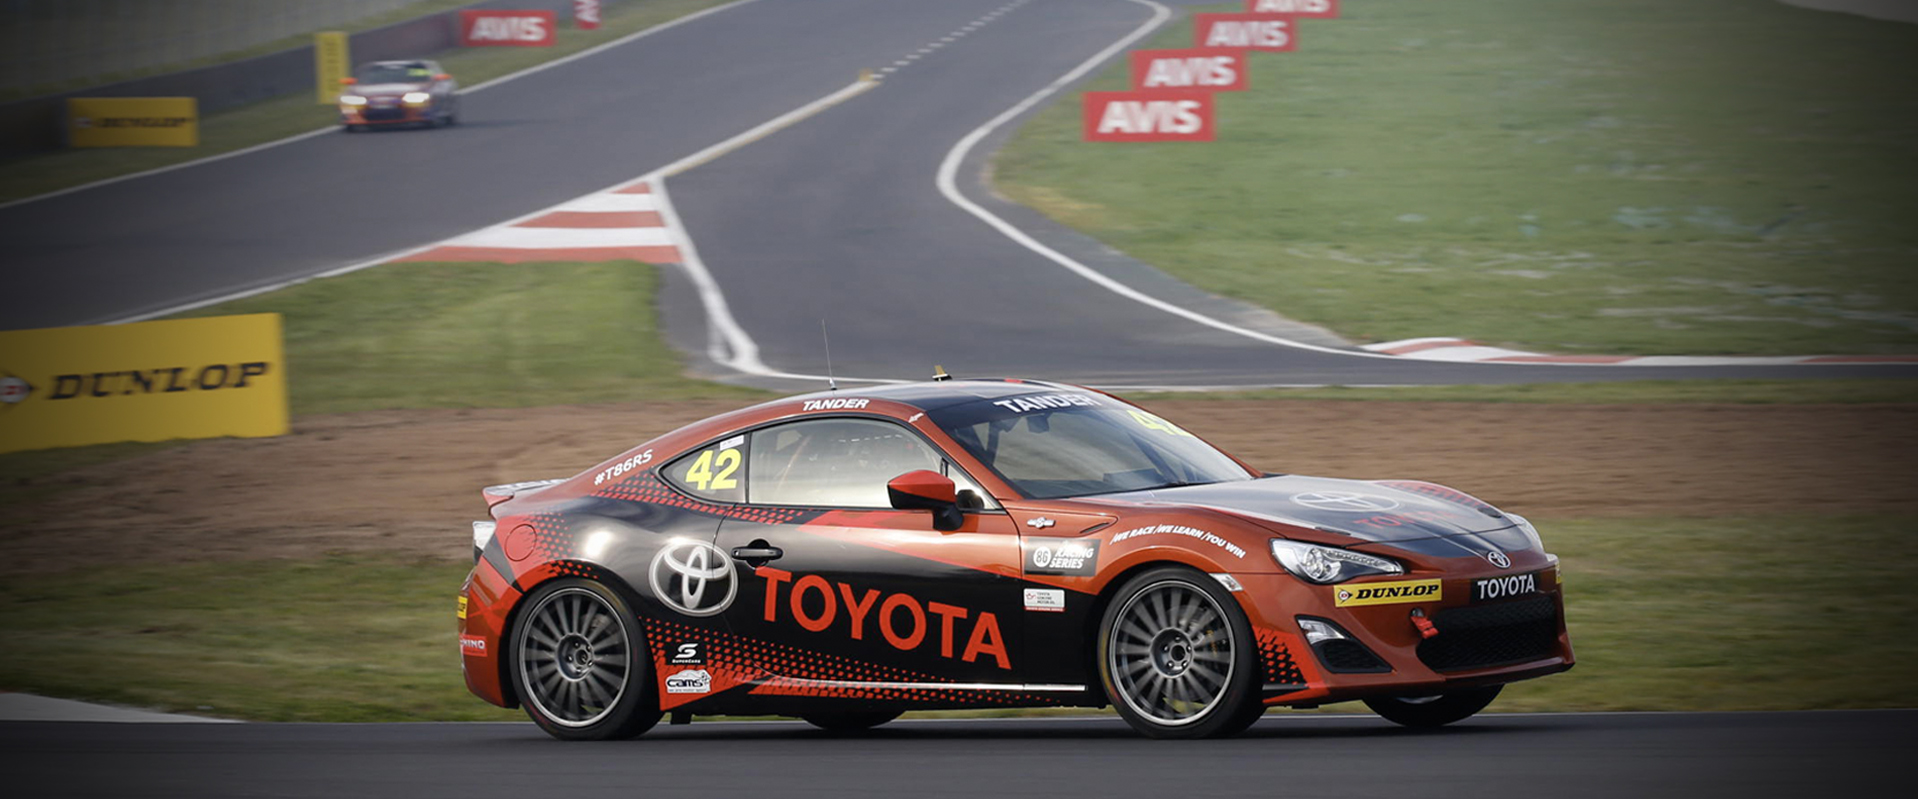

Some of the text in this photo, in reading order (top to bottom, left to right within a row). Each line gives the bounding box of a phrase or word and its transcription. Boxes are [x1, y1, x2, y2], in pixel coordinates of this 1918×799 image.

[1205, 21, 1288, 47] AVIS
[1143, 56, 1236, 87] AVIS
[1097, 100, 1202, 133] AVIS
[48, 361, 271, 400] DUNLOP
[802, 398, 870, 411] TANDER
[993, 394, 1102, 413] TANDER
[594, 449, 653, 486] #T86RS
[685, 448, 742, 490] 42
[1129, 525, 1156, 538] RACE
[1172, 525, 1204, 539] LEARN
[1223, 542, 1246, 559] WIN
[1035, 550, 1049, 564] 86
[1049, 557, 1084, 569] SERIES
[1356, 584, 1439, 600] DUNLOP
[1477, 573, 1536, 600] TOYOTA
[755, 566, 1012, 670] TOYOTA
